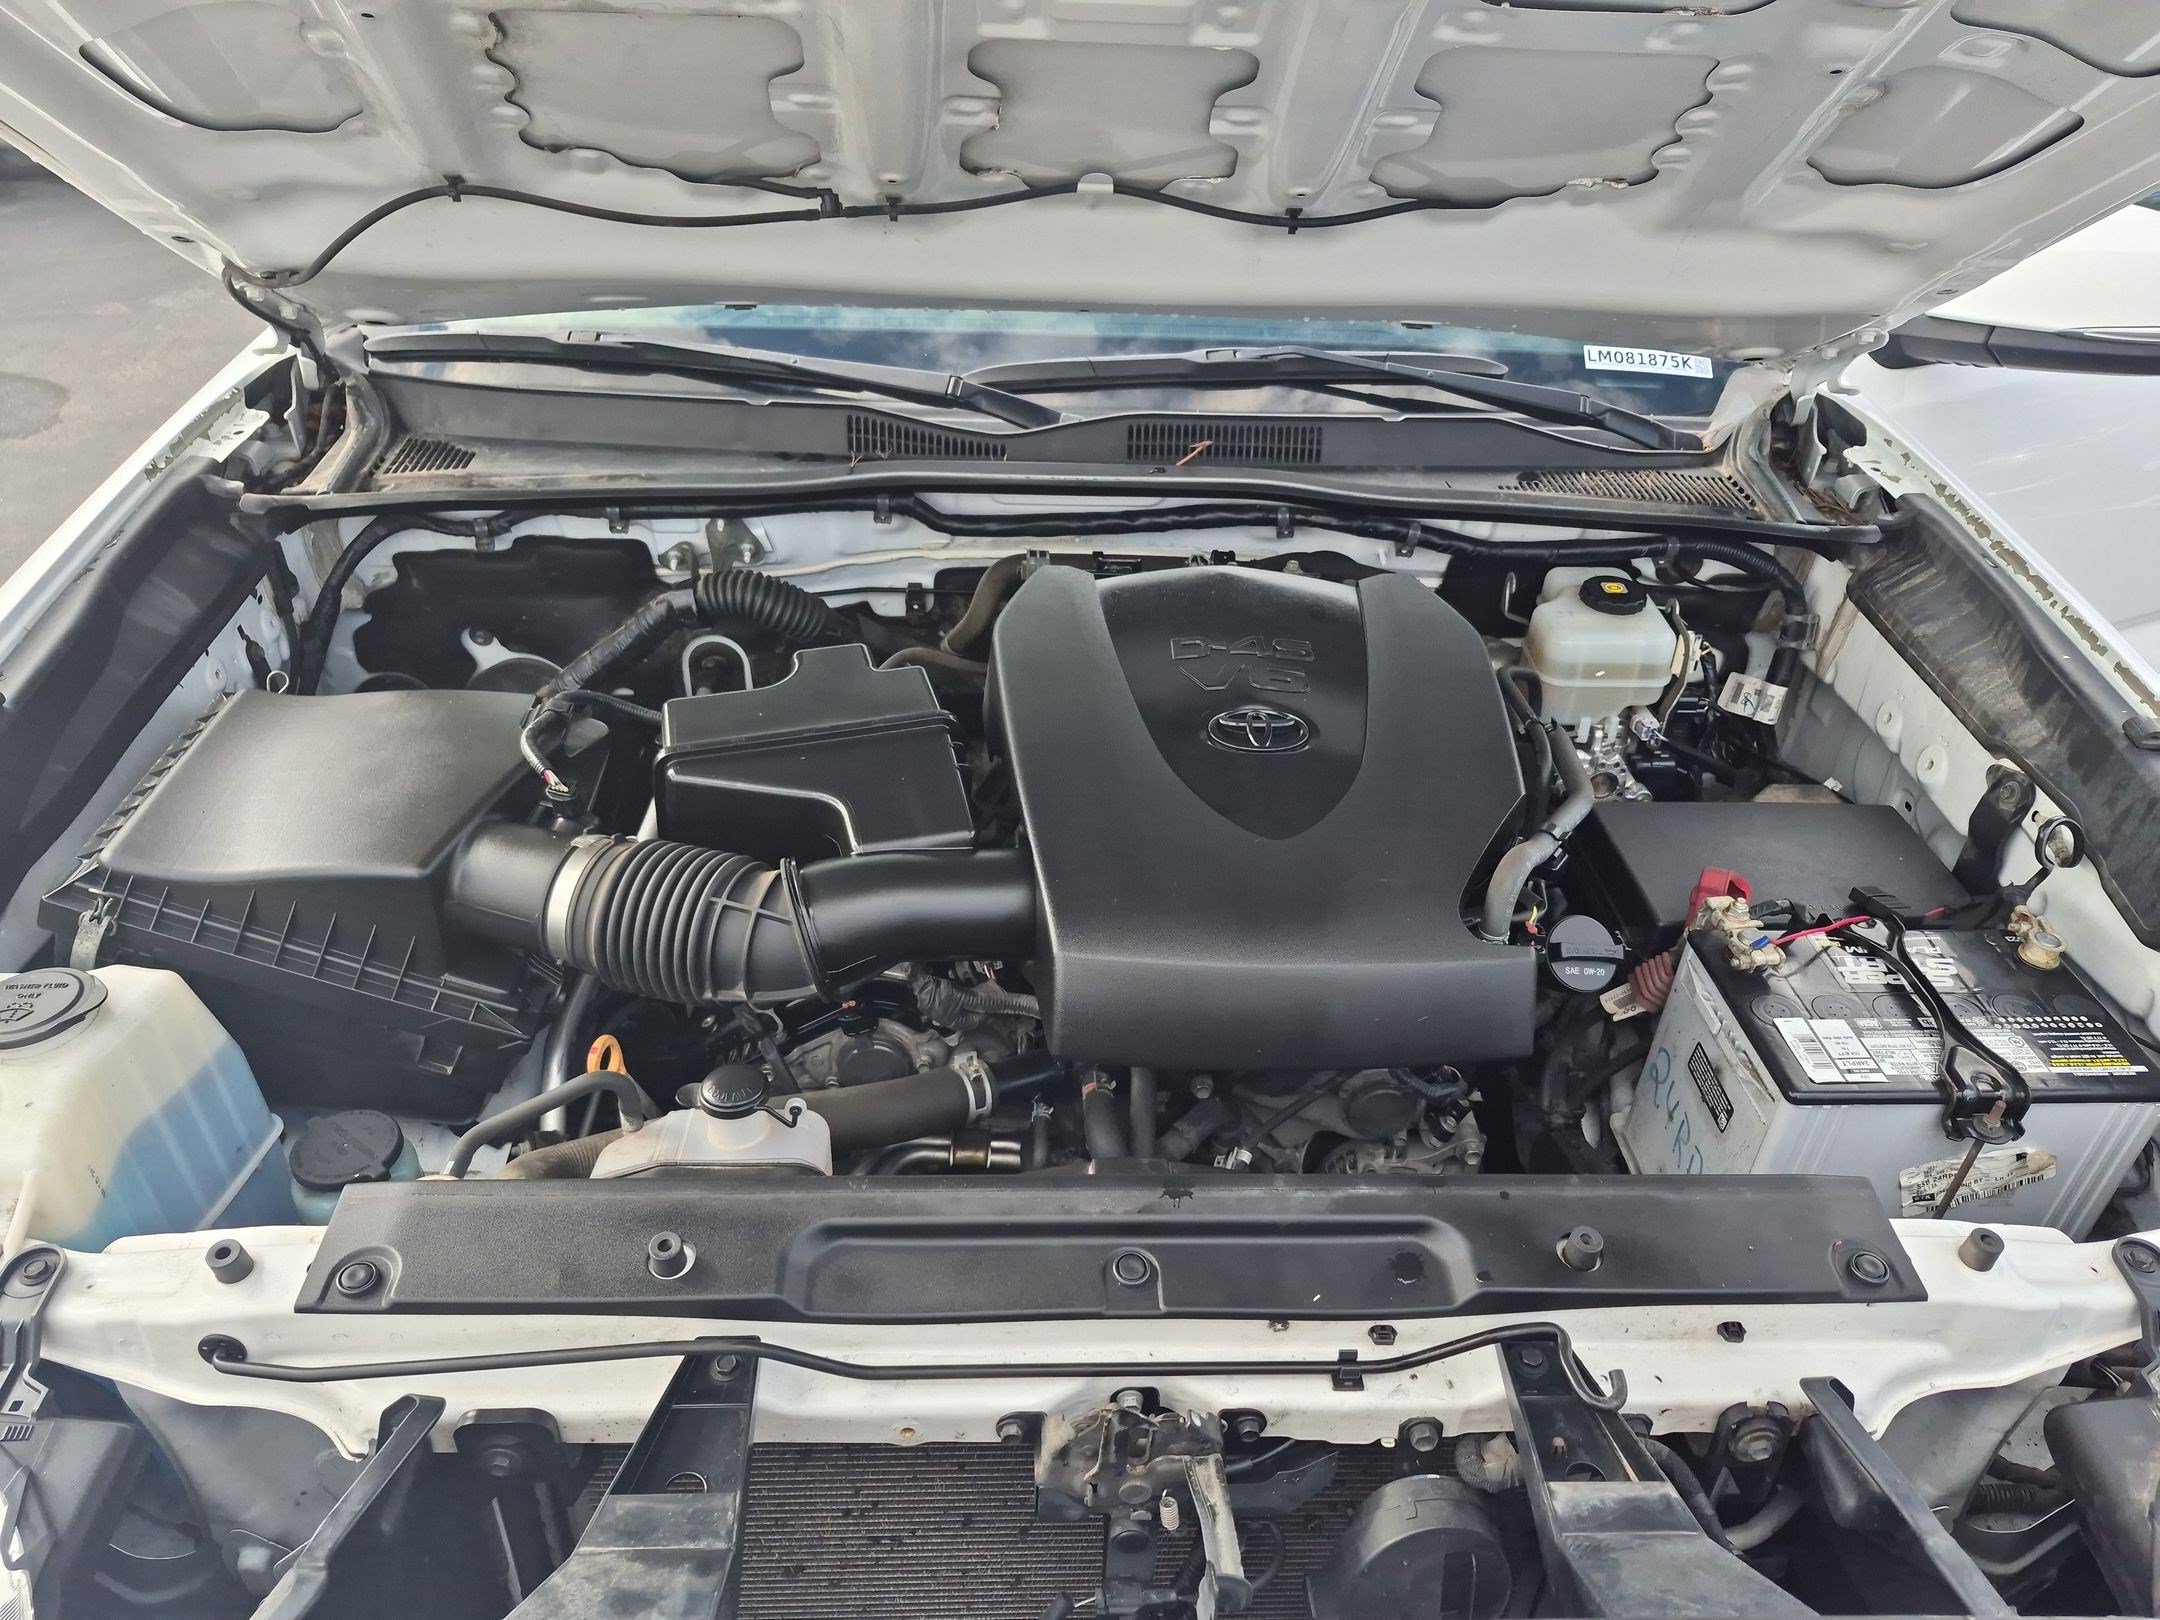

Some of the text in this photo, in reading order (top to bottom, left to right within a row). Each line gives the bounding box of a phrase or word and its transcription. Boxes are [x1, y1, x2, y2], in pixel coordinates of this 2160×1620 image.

[1588, 349, 1693, 369] LM081875K
[1565, 966, 1606, 977] SAE 0W-20
